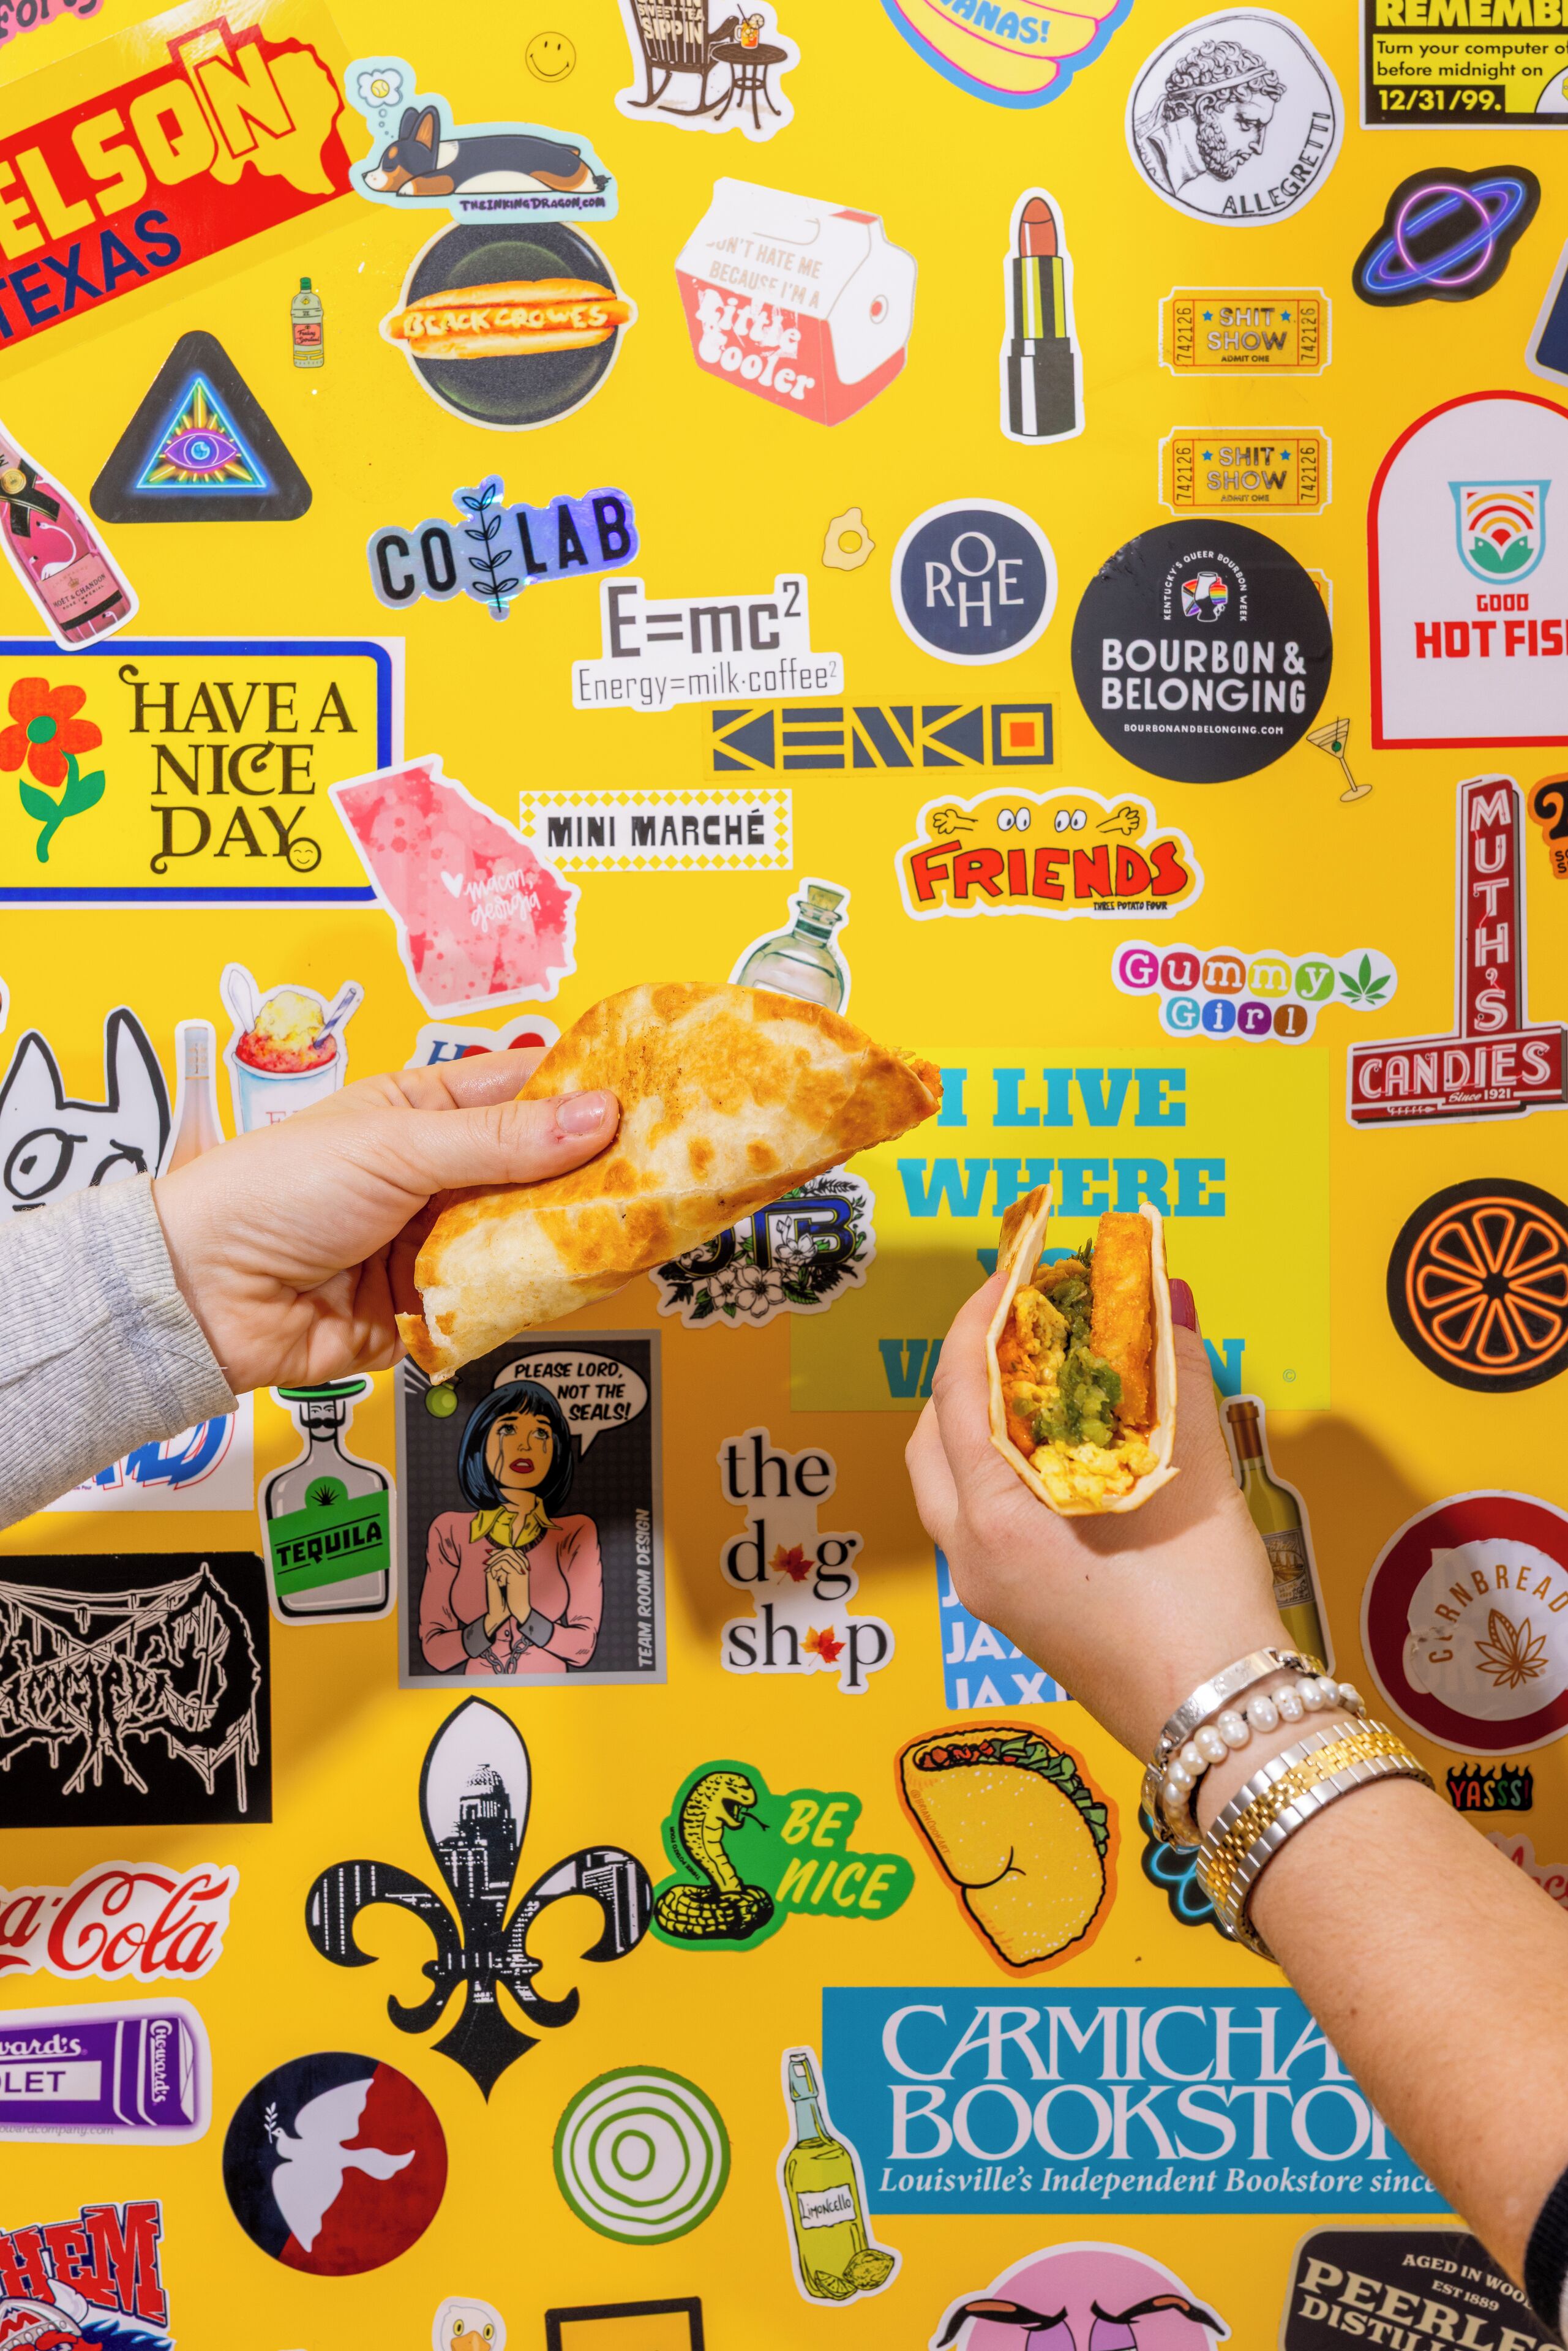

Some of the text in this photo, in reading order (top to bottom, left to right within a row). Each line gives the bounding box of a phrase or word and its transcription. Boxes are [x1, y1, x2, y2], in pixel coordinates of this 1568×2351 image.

[637, 4, 677, 18] SWEET
[679, 7, 705, 21] TEA
[642, 17, 702, 44] SIPPIN
[940, 0, 1051, 44] ANAS!
[1375, 0, 1568, 26] REMEMB
[1377, 40, 1568, 62] Turn your computer o
[1377, 62, 1544, 80] before midnight on
[1379, 89, 1502, 111] 12/31/99.
[1222, 112, 1331, 214] ALLEGRETTI
[0, 210, 181, 339] TEXAS
[756, 244, 795, 271] HATE
[797, 256, 822, 279] ME
[708, 260, 820, 309] BECAUSE I'M A
[403, 305, 608, 337] BLACK CROWES
[1177, 307, 1192, 361] 742126
[1220, 308, 1275, 326] SHIT
[1300, 307, 1317, 361] 742126
[1207, 331, 1287, 351] SHOW
[1177, 447, 1192, 501] 742126
[1220, 448, 1275, 466] SHIT
[1300, 447, 1317, 501] 742126
[1207, 471, 1287, 490] SHOW
[75, 573, 106, 596] CHANDON
[1163, 561, 1183, 620] KENTUCKY'S
[1184, 550, 1214, 563] QUEER
[1217, 553, 1247, 591] BOURBON
[1476, 593, 1529, 612] GOOD
[1102, 639, 1307, 675] BOURBON &
[1414, 620, 1568, 659] HOT FIS
[118, 664, 358, 733] HAVE A
[1101, 677, 1306, 713] BELONGING
[712, 703, 1054, 771] KENKO
[1124, 724, 1283, 734] BOURBONANDBELONGING.COM
[151, 740, 316, 796] NICE
[150, 803, 309, 874] DAY
[547, 808, 765, 848] MINI MARCHÉ
[463, 869, 534, 902] macon,
[910, 839, 1188, 902] FRIENDS
[471, 891, 542, 932] georgia
[1093, 901, 1168, 910] THREE POTATO FOUR
[1470, 787, 1512, 1032] MUTH'S
[1125, 953, 1330, 998] Gummy
[1171, 1000, 1296, 1035] Girl
[1359, 1041, 1551, 1098] CANDIES
[937, 1068, 1187, 1127] I LIVE
[1449, 1087, 1512, 1103] Since 1921
[896, 1158, 1226, 1217] WHERE
[514, 1362, 623, 1379] PLEASE LORD,
[557, 1383, 626, 1399] NOT THE
[568, 1402, 631, 1422] SEALS!
[724, 1434, 831, 1499] the
[276, 1521, 382, 1566] TEQUILA
[727, 1518, 857, 1602] dg
[636, 1508, 653, 1668] TEAM ROOM DESIGN
[727, 1603, 888, 1687] shp
[946, 1621, 1023, 1664] JA
[1450, 1779, 1529, 1807] YASSS!
[781, 1799, 849, 1848] BE
[776, 1858, 897, 1910] NICE
[0, 2071, 66, 2093] LET
[879, 2165, 1032, 2194] Louisville's
[1041, 2167, 1218, 2199] Independent
[1225, 2166, 1363, 2194] Bookstore
[1402, 2254, 1458, 2274] AGED
[1460, 2265, 1483, 2283] IN
[1297, 2257, 1562, 2351] PEERLE
[1431, 2279, 1500, 2312] EST 1889
